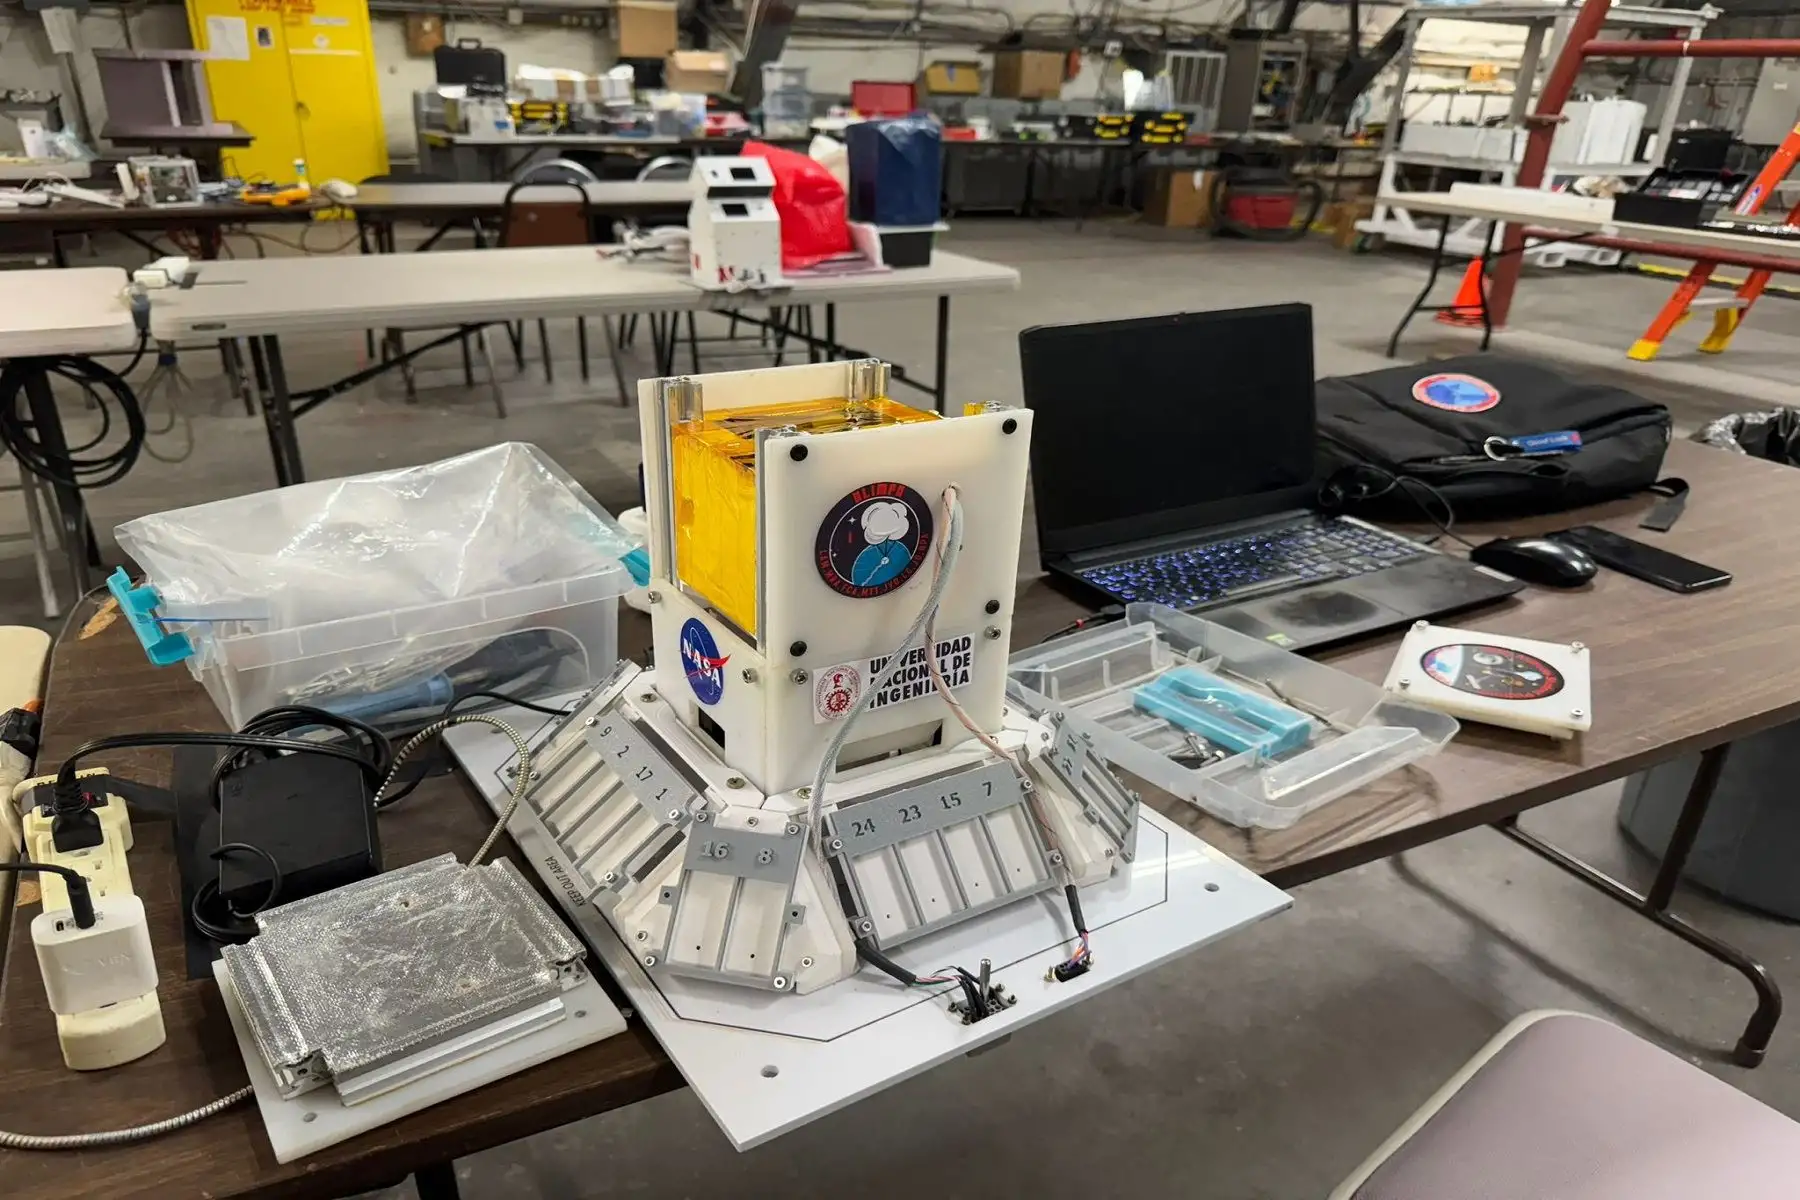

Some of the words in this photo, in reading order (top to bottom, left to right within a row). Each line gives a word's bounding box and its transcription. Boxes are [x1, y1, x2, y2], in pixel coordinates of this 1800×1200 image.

[683, 637, 721, 689] NASA
[870, 636, 971, 674] UNVERIDAD
[870, 659, 947, 690] ACIONL
[952, 653, 971, 670] DE
[600, 726, 612, 737] 9
[617, 745, 630, 758] 2
[636, 766, 654, 782] 17
[656, 788, 668, 801] 1
[851, 818, 876, 837] 24
[898, 804, 922, 824] 23
[940, 792, 962, 810] 15
[982, 781, 992, 796] 7
[544, 856, 564, 874] AREA
[703, 840, 730, 860] 16
[757, 848, 774, 865] 8
[556, 874, 575, 890] OUT
[567, 890, 587, 907] KEEP
